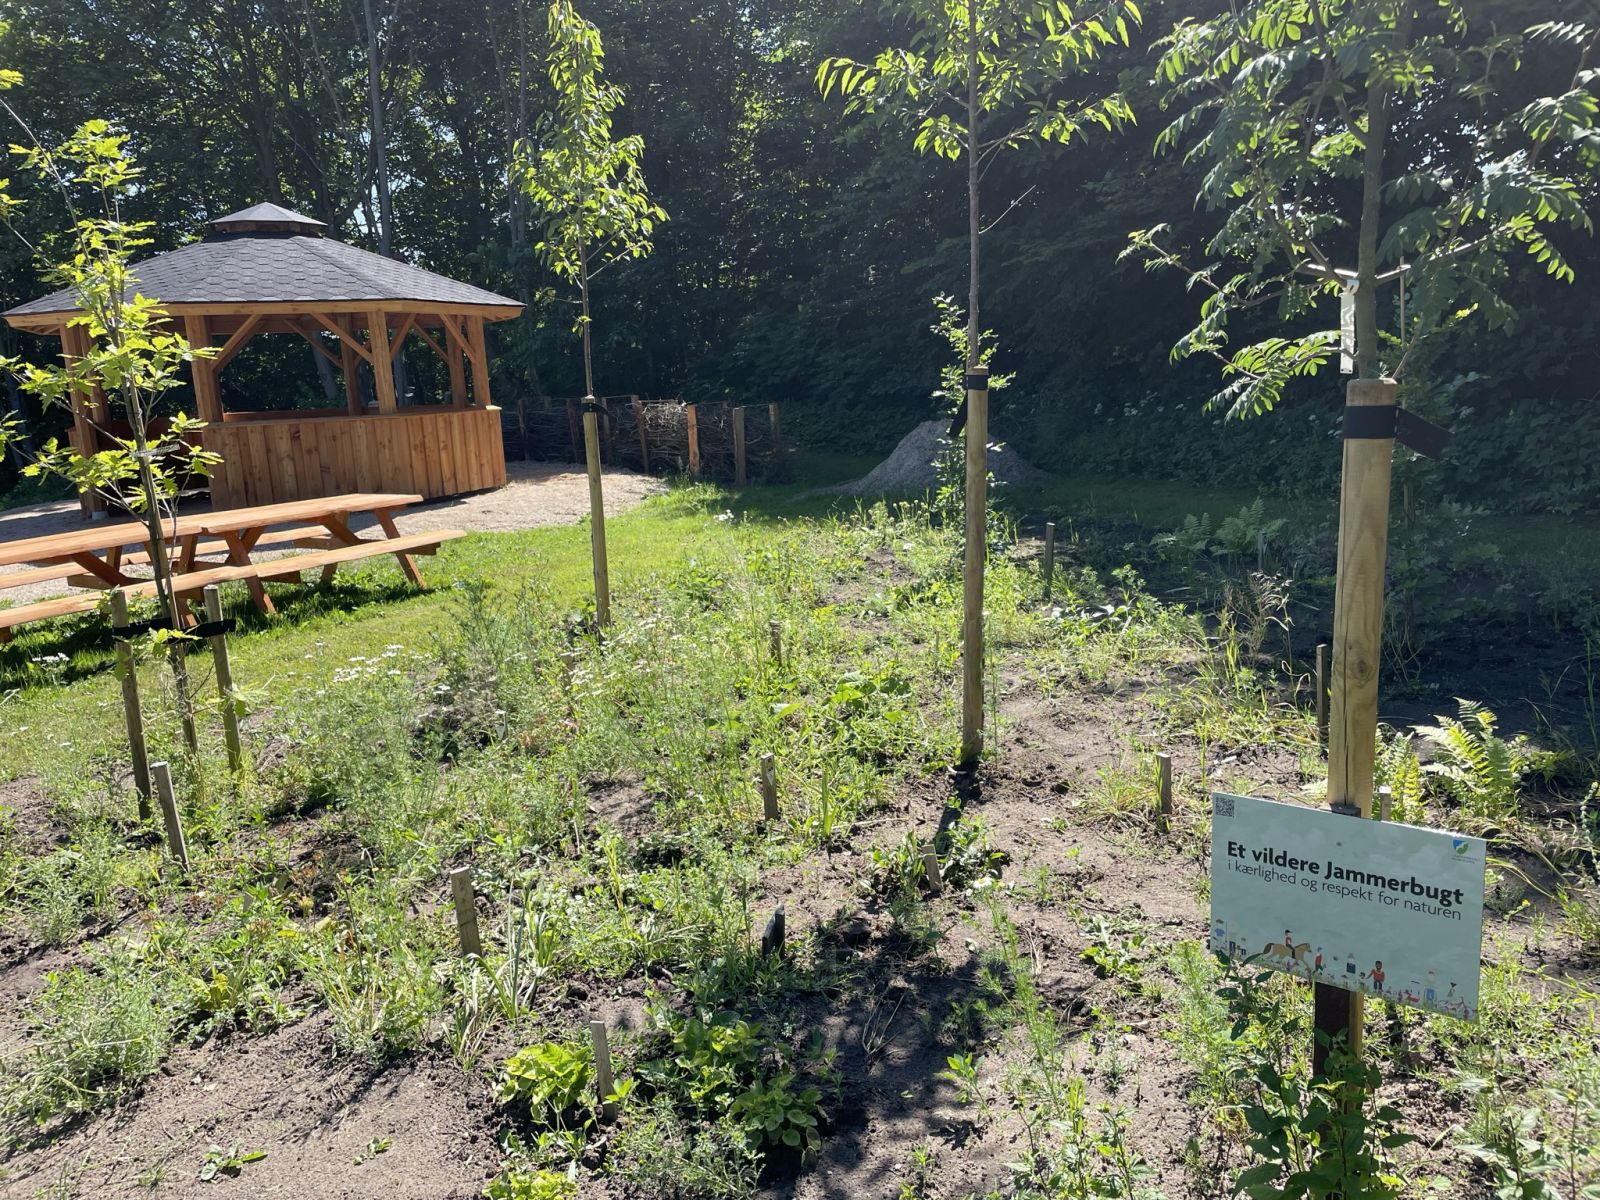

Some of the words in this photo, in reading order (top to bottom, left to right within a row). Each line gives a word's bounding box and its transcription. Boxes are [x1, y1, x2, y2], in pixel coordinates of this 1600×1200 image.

[1227, 841, 1245, 859] Et
[1252, 847, 1320, 875] vildere
[1324, 861, 1464, 908] Jammerbugt
[1228, 860, 1231, 871] i
[1235, 861, 1296, 886] kærlighed
[1301, 878, 1317, 892] og
[1322, 883, 1374, 902] respekt
[1378, 891, 1400, 907] for
[1404, 900, 1461, 920] naturen
